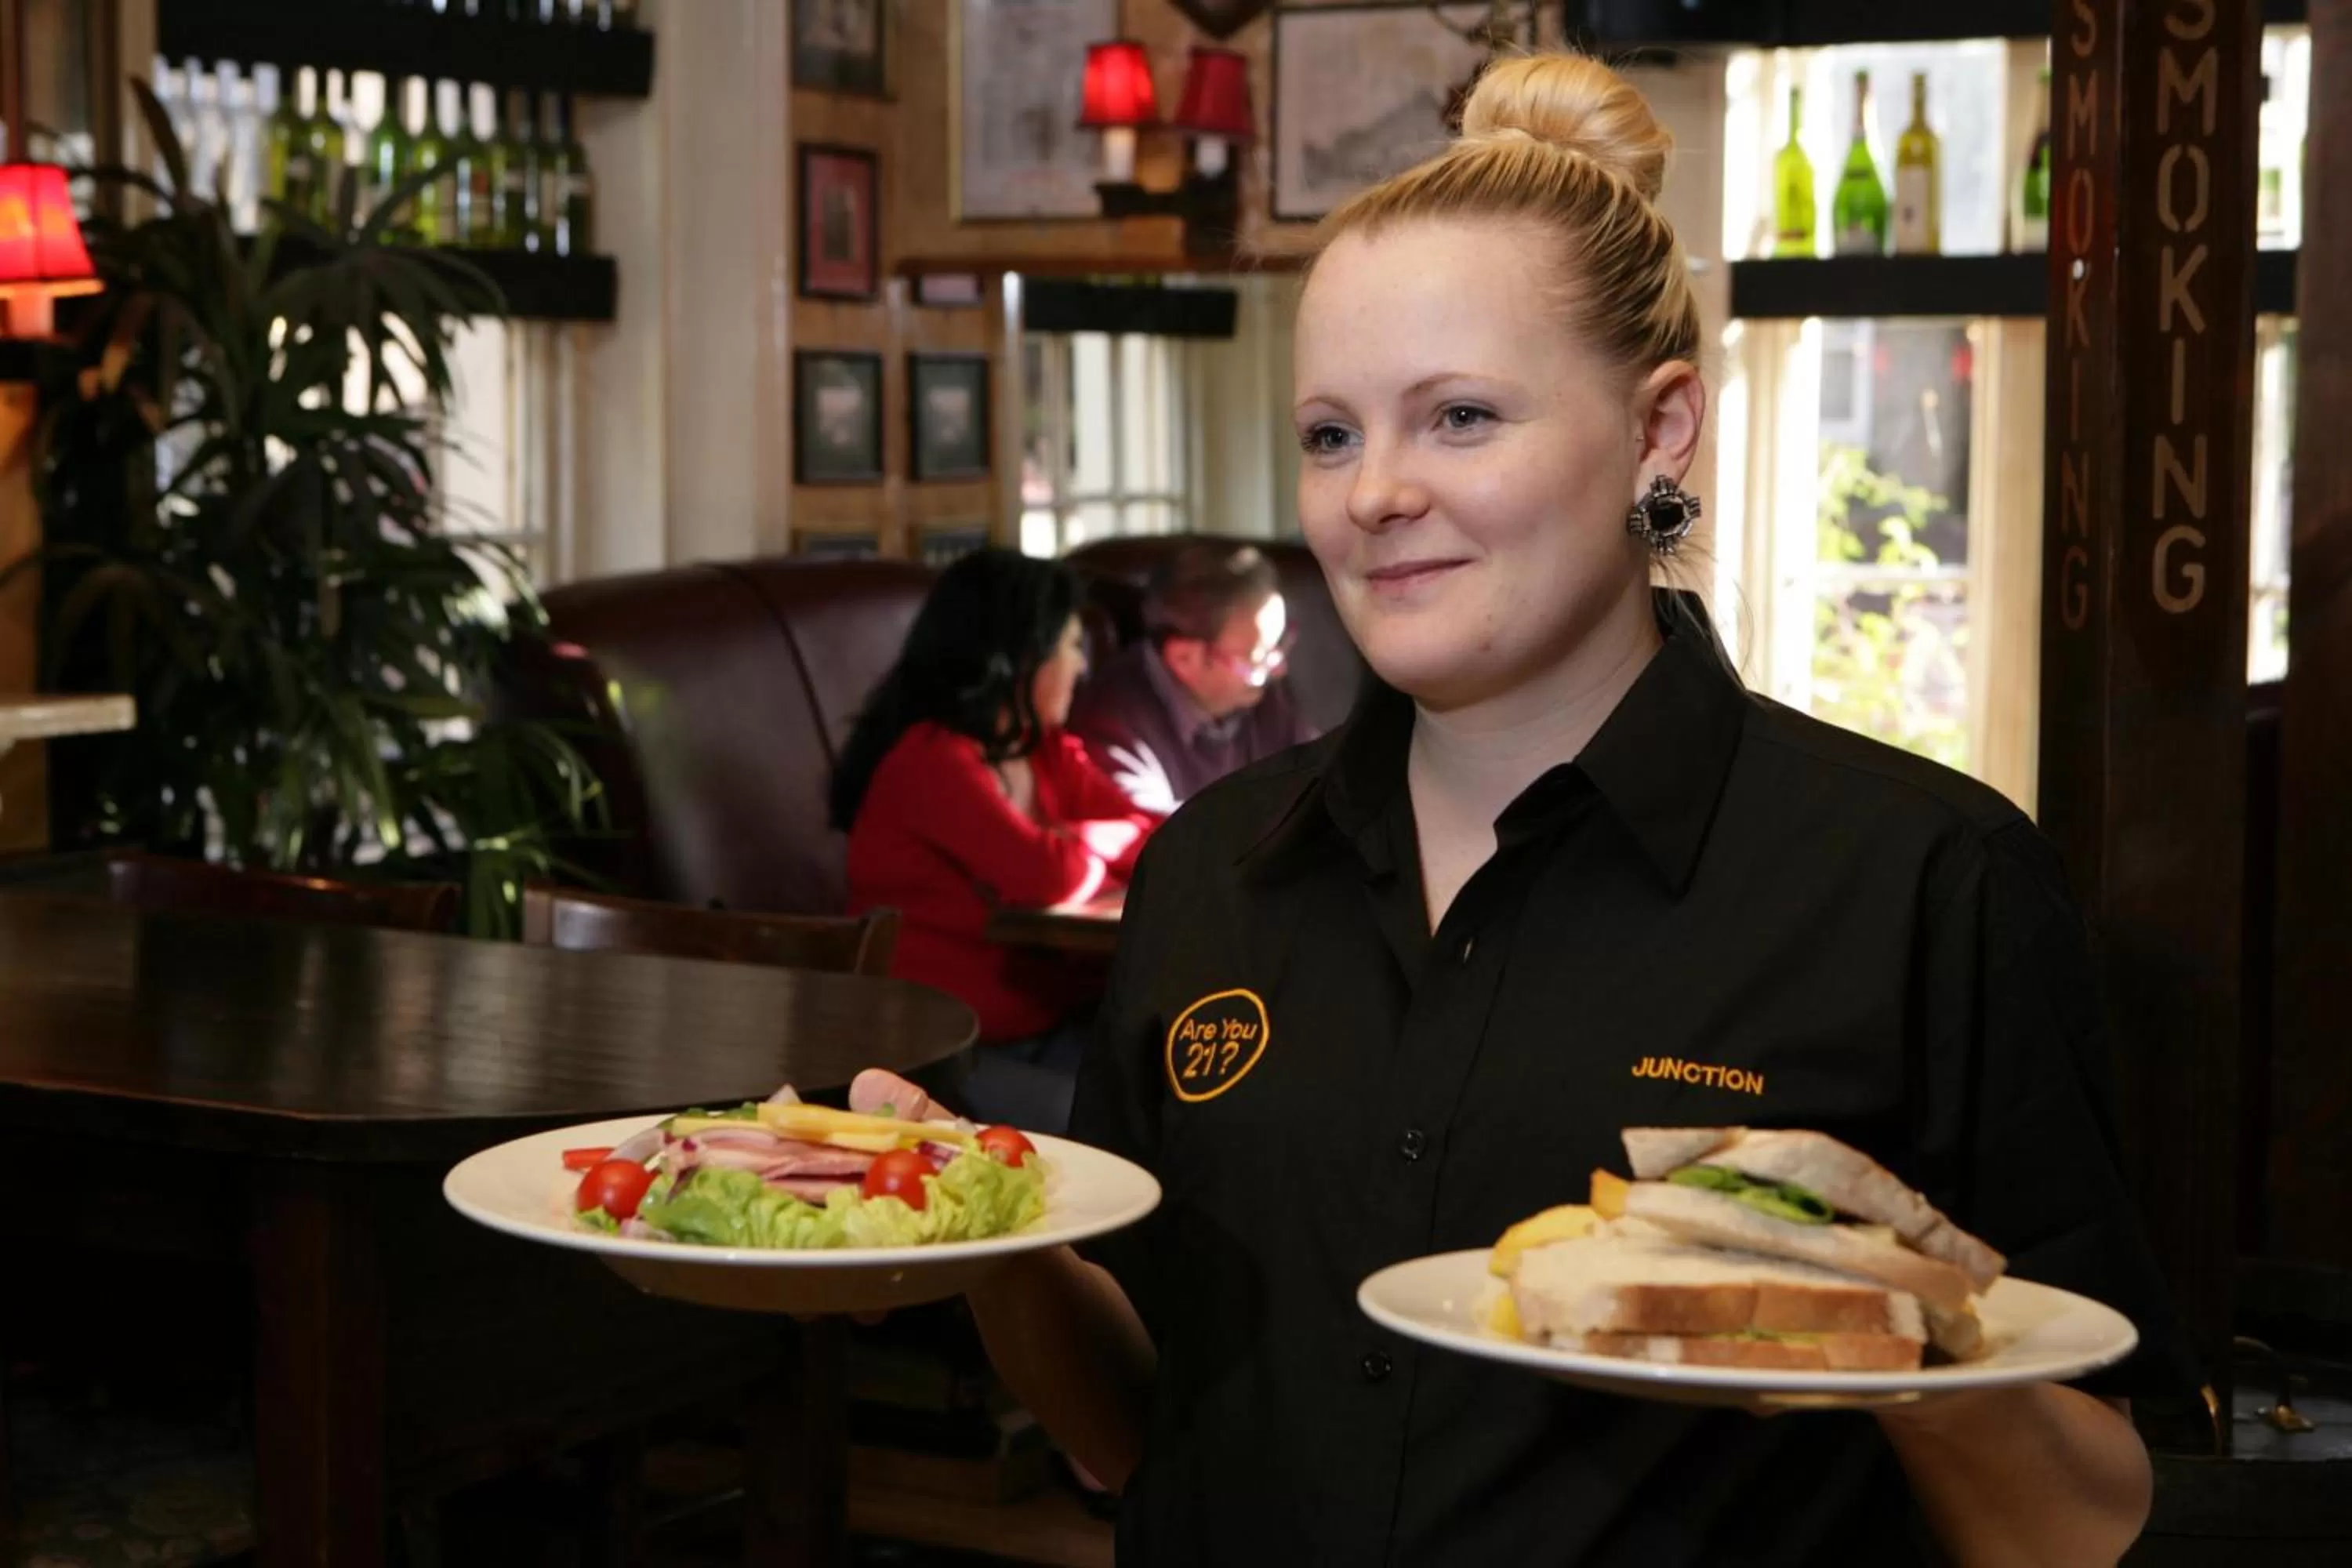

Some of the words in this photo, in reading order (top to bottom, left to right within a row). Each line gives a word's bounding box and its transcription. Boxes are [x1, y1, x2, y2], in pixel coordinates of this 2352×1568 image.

[1179, 1018, 1217, 1041] Are
[1222, 1018, 1258, 1040] You
[1631, 1056, 1764, 1095] JUNCTION
